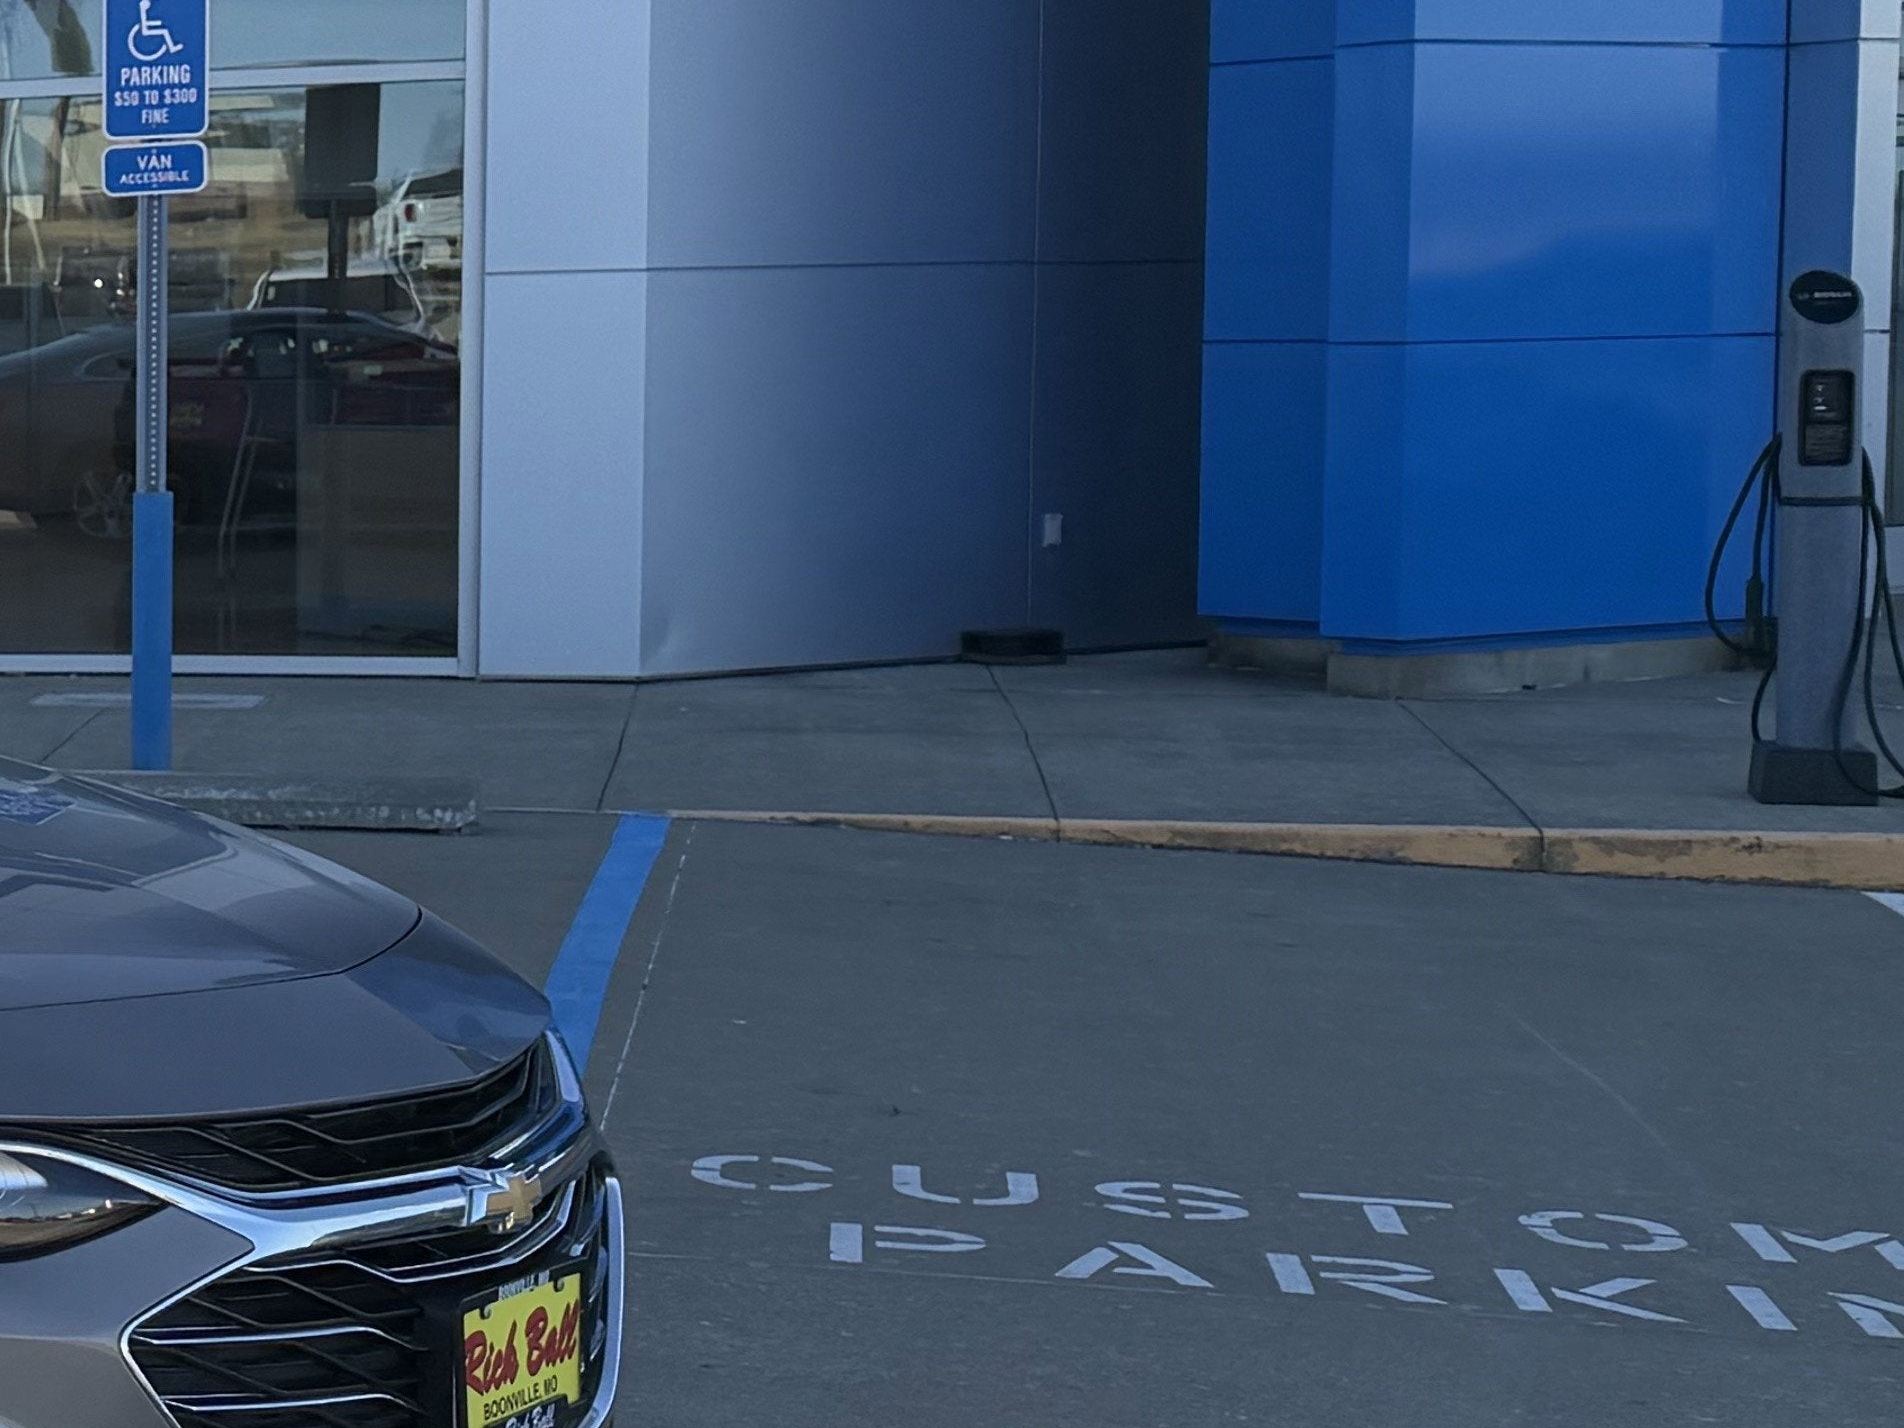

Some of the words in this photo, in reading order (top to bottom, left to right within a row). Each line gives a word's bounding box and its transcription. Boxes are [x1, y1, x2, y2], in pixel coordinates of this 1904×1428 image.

[120, 64, 191, 86] PARKING
[114, 91, 139, 106] $50
[145, 90, 159, 105] TO
[164, 88, 197, 103] $300
[142, 108, 169, 124] FINE
[137, 155, 172, 169] VAN
[120, 170, 189, 185] ACCESSIBLE
[690, 1154, 1904, 1270] CUSTOM
[464, 1319, 519, 1396] Rick
[525, 1298, 580, 1376] Ball
[544, 1375, 558, 1395] MO
